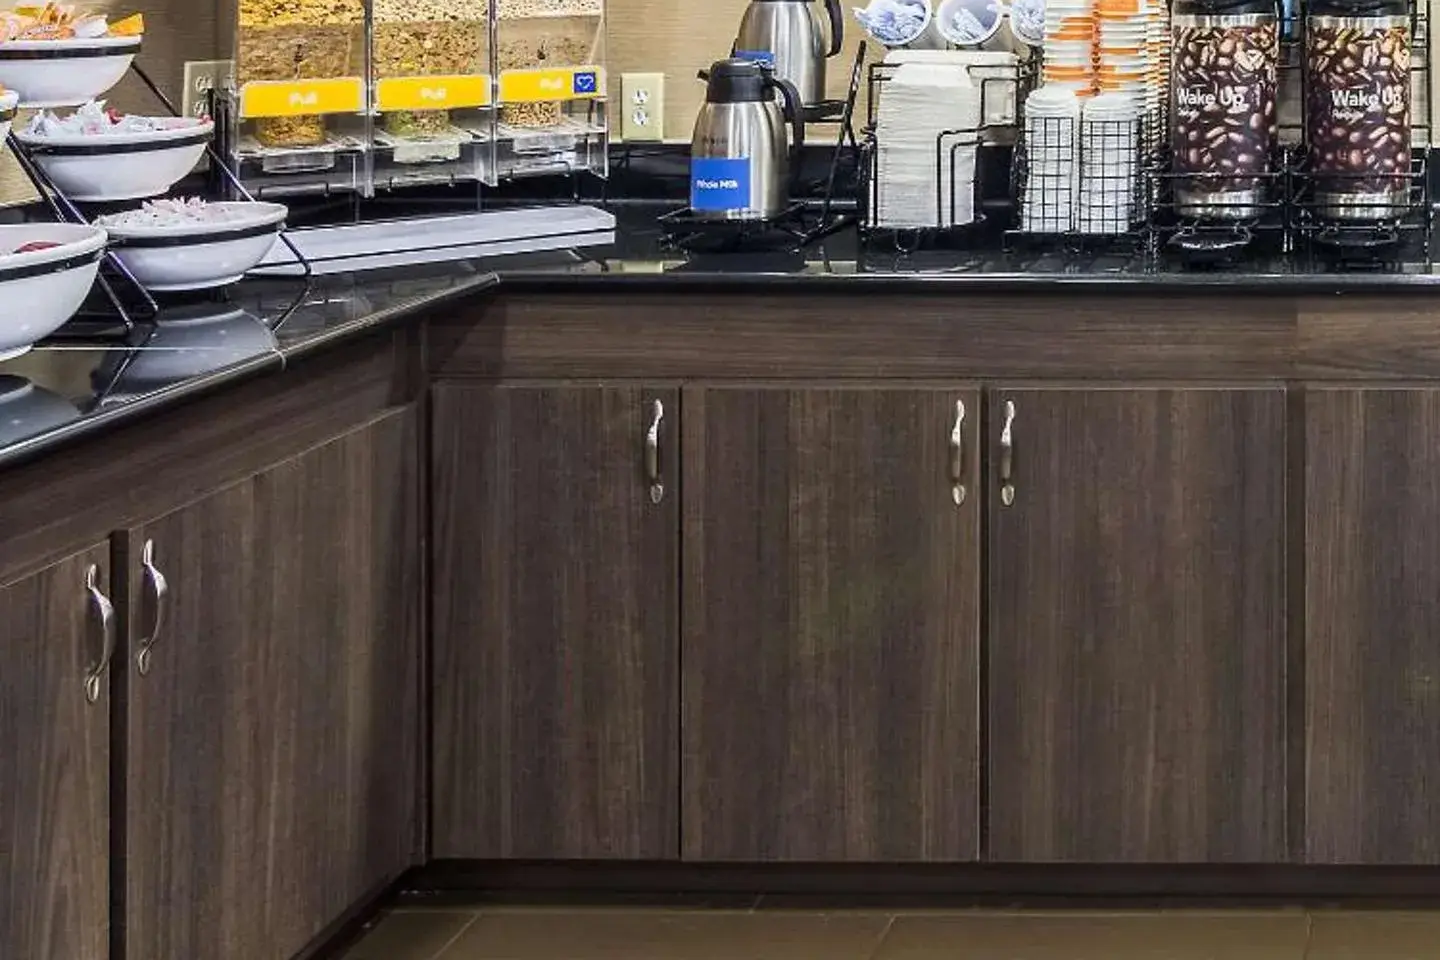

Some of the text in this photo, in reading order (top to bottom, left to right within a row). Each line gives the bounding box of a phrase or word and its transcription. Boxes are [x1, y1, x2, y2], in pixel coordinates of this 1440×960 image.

[1176, 86, 1245, 109] Wake Up
[1331, 89, 1379, 107] Wake
